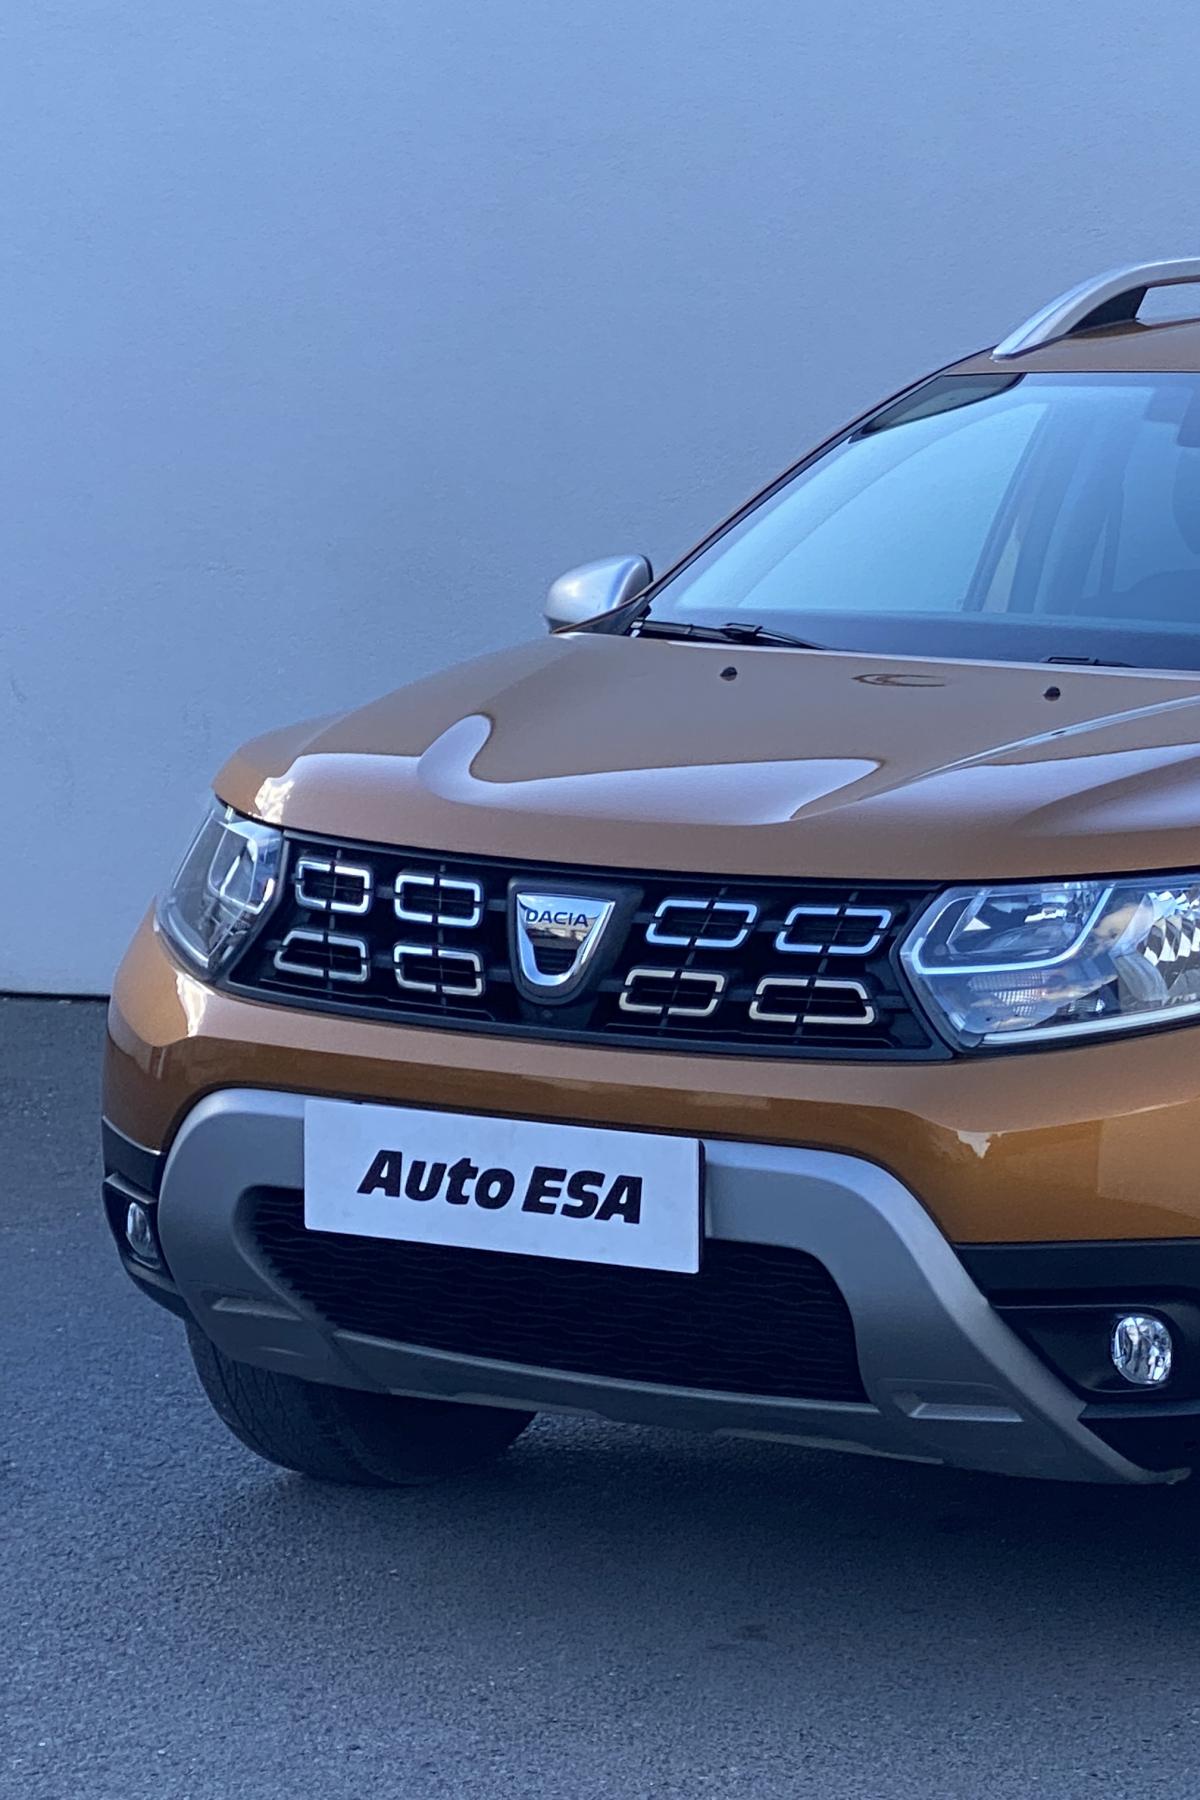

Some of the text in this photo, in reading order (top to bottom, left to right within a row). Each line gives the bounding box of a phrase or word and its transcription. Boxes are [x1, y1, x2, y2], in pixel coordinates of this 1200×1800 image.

[526, 910, 588, 927] DACIA
[357, 1149, 643, 1224] Auto ESA
